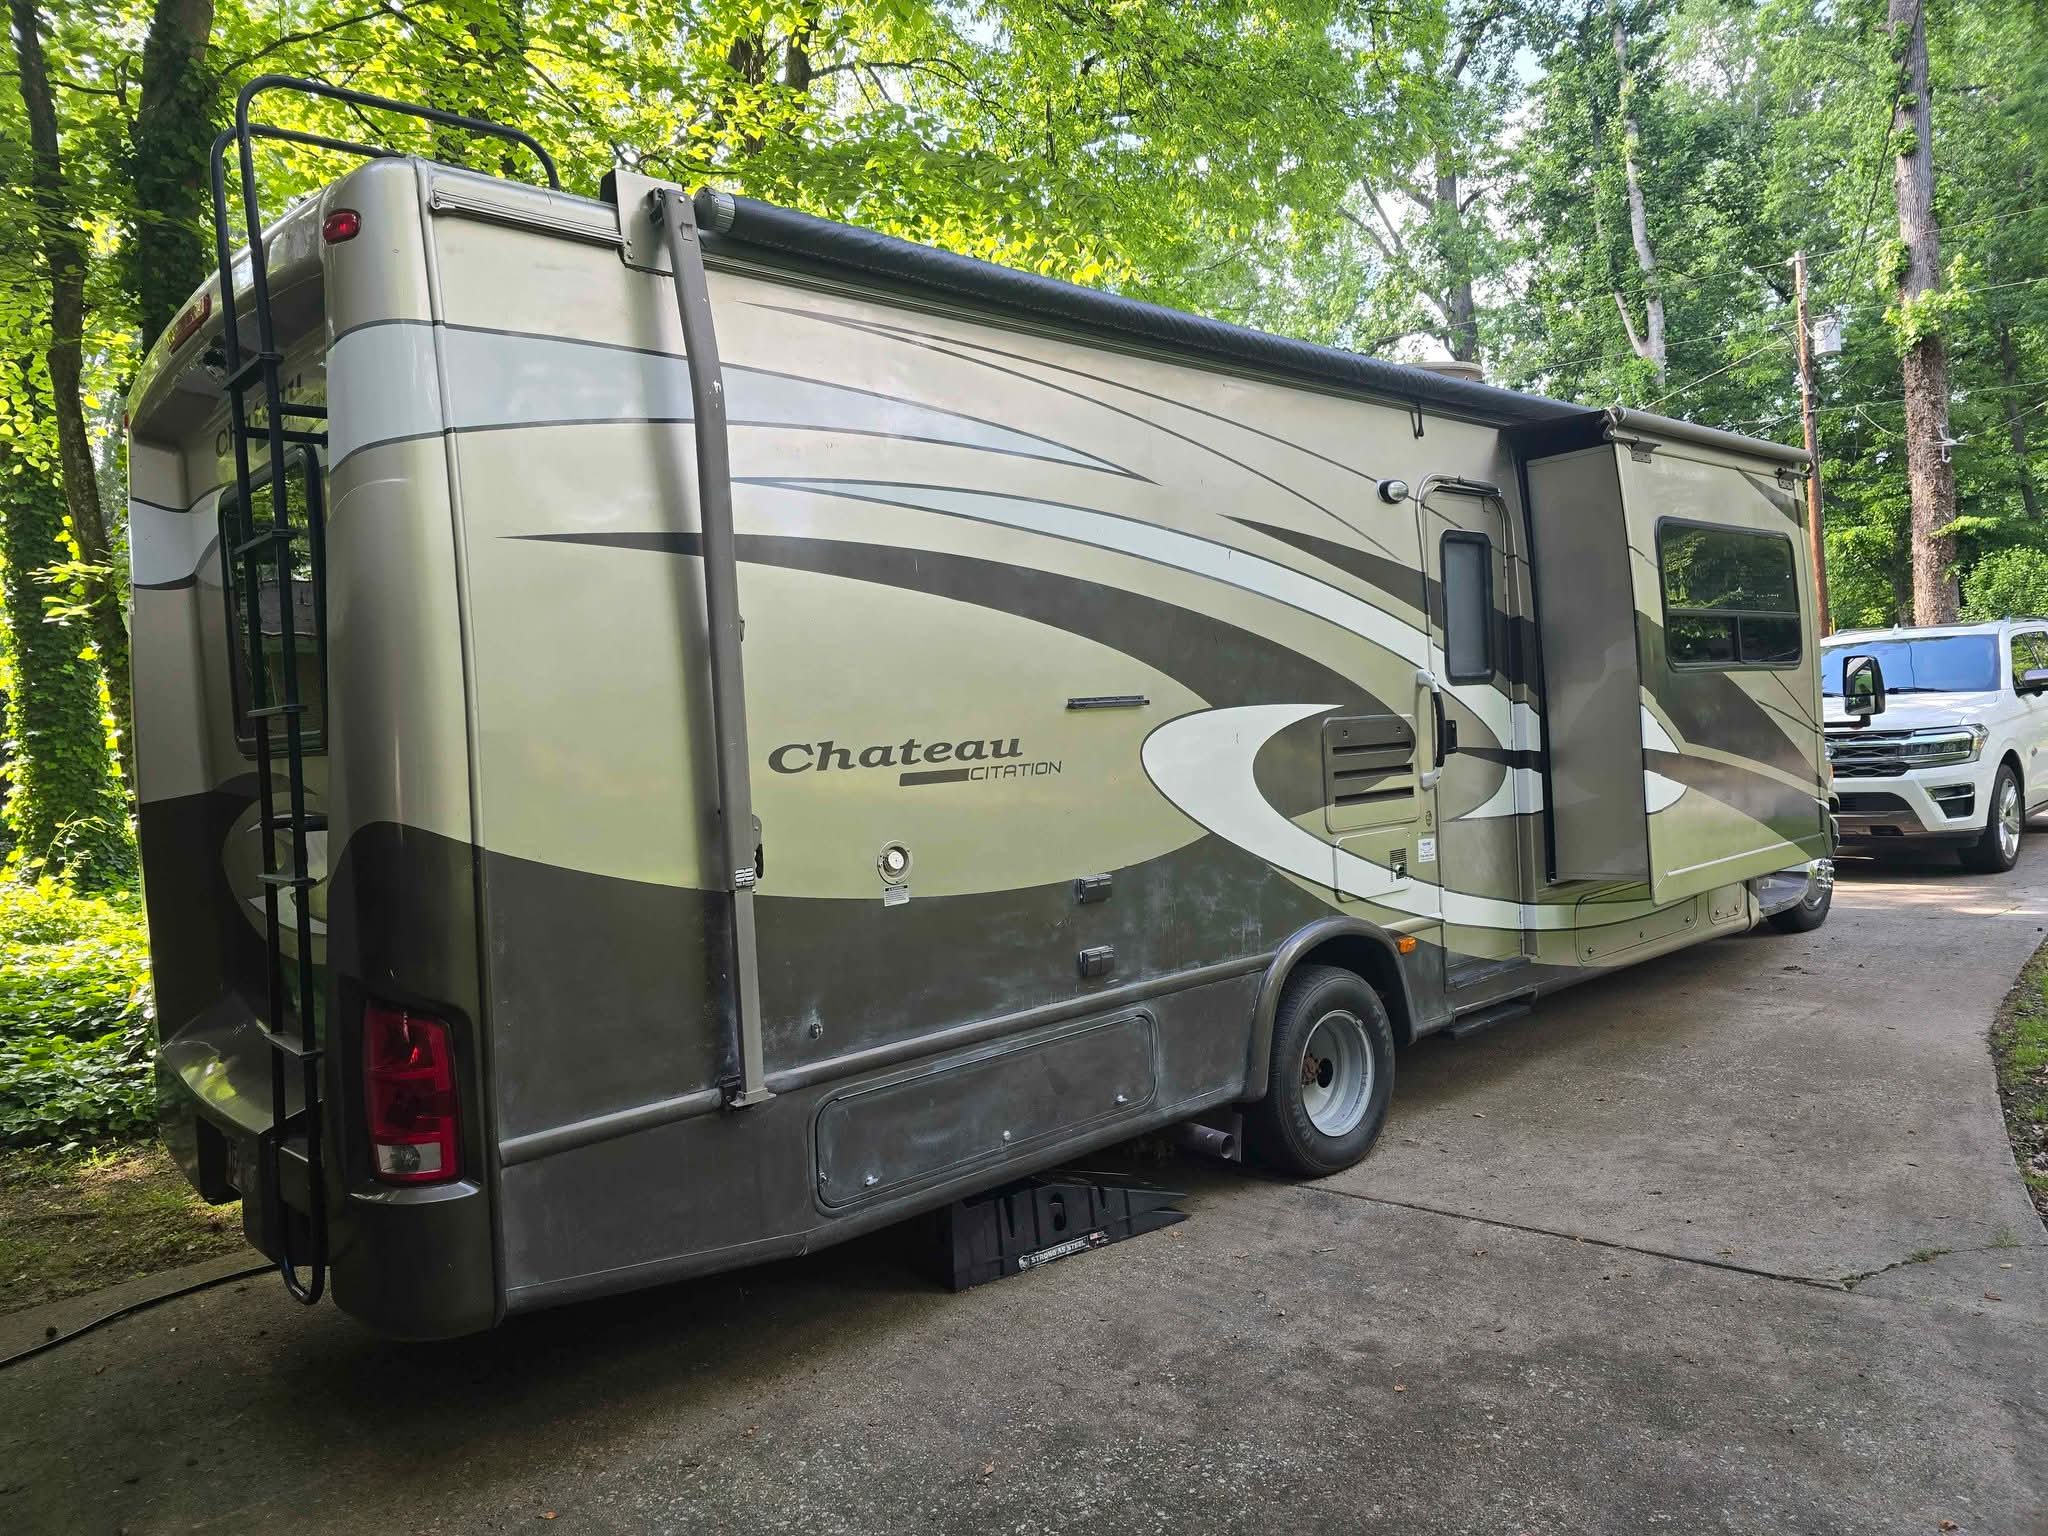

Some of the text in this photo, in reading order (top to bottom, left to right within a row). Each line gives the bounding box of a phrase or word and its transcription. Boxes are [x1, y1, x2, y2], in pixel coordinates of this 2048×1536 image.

[768, 738, 1023, 774] Chateau
[969, 760, 1062, 781] CITATION
[1031, 1240, 1086, 1263] STRONG AS STEEL
